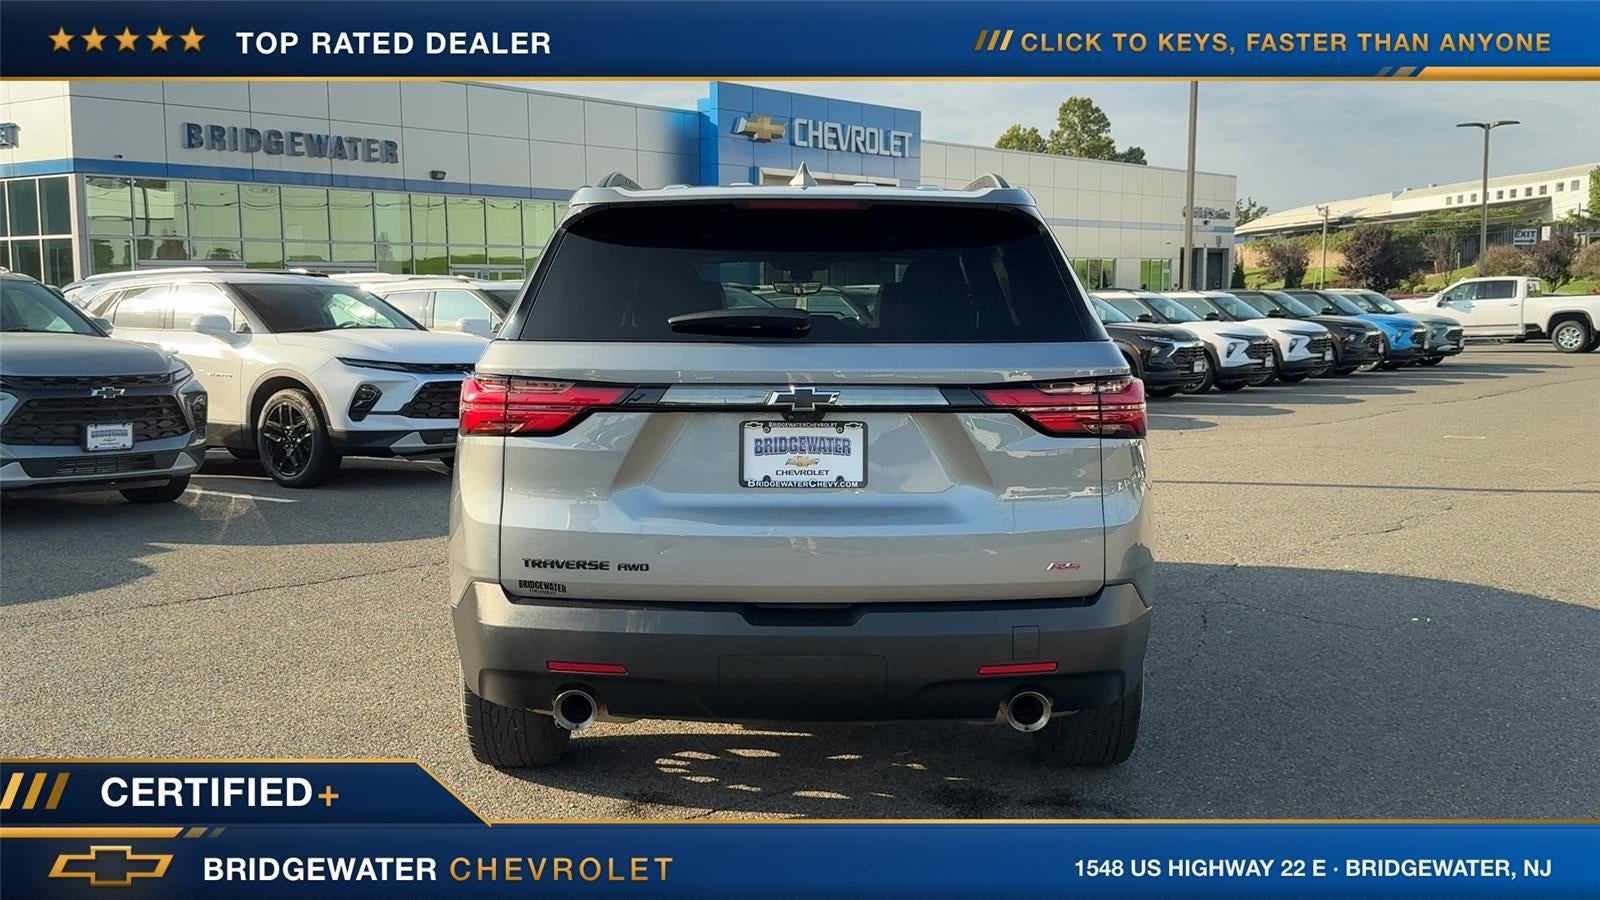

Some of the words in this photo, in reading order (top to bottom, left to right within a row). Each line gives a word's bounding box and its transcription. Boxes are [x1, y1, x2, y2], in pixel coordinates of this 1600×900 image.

[182, 121, 399, 164] BRIDGEWATER
[794, 118, 912, 158] CHEVROLET
[1515, 230, 1536, 238] EXIT
[754, 436, 852, 457] BRIDGEWATER
[522, 558, 610, 571] TRAVERSE
[617, 562, 650, 571] AWD
[518, 579, 568, 593] BRIDGEWATER
